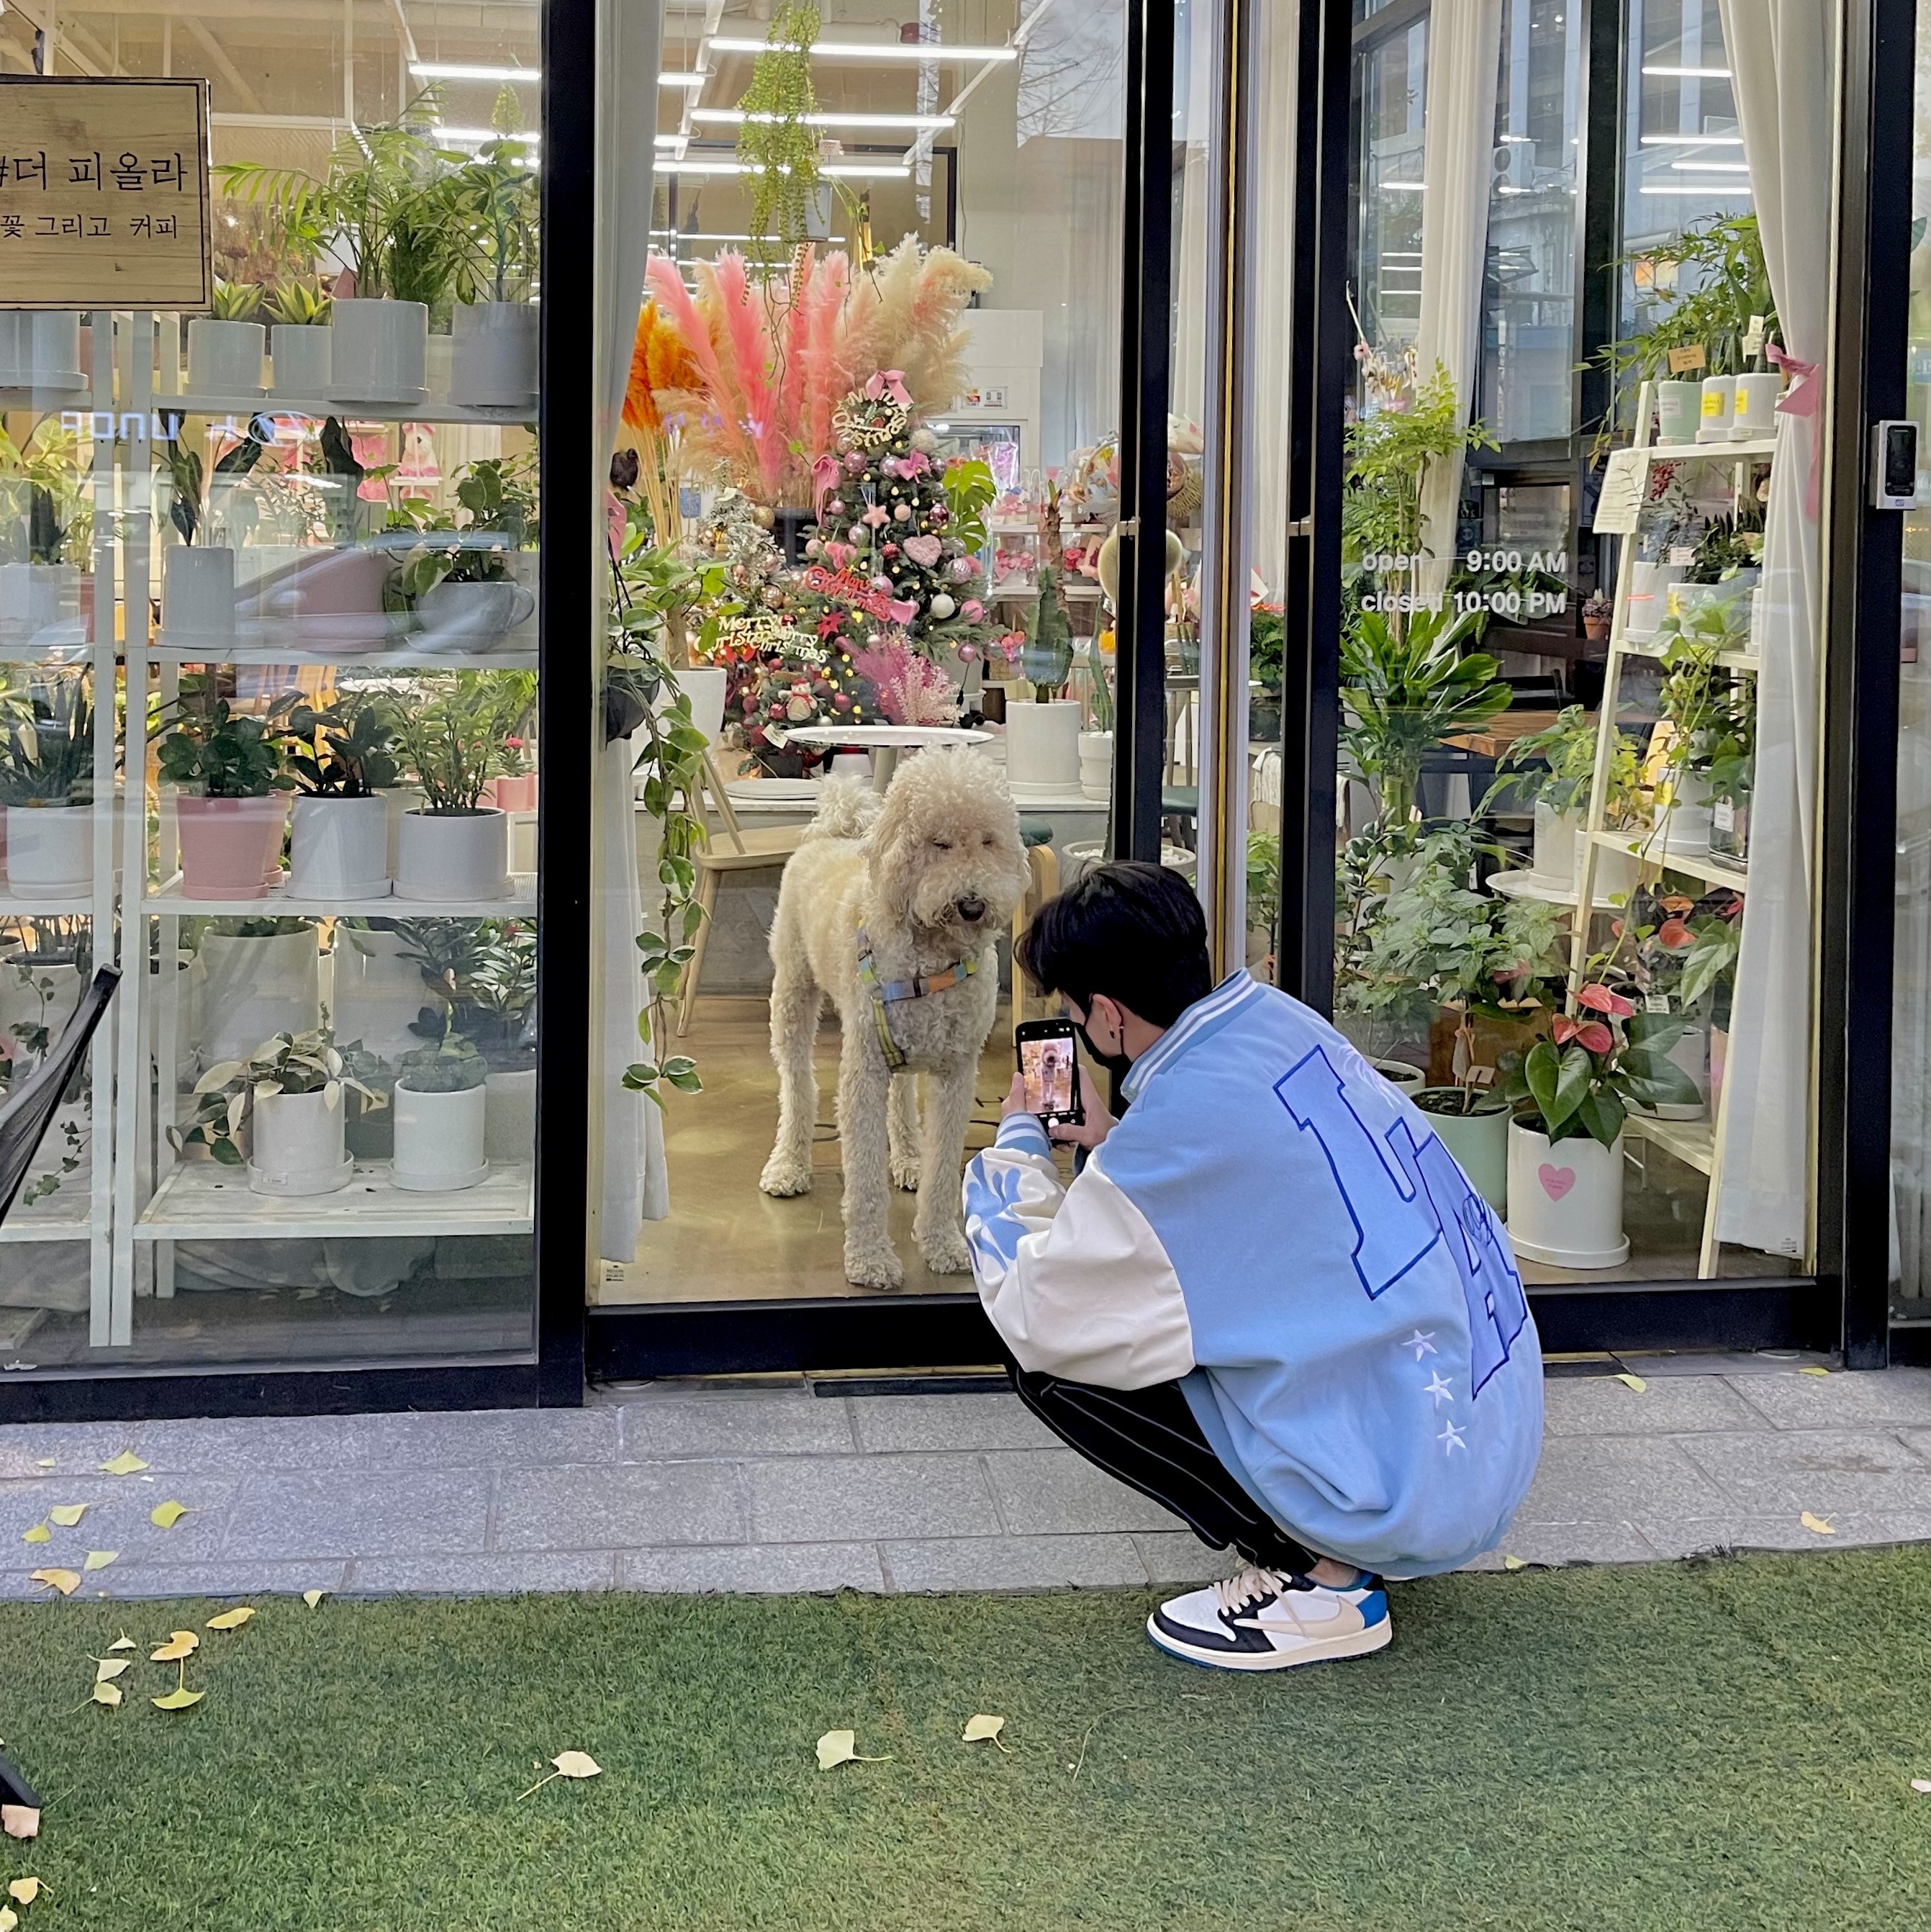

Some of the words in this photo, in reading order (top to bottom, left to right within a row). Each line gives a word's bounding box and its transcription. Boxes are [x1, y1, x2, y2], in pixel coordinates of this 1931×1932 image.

[69, 152, 189, 191] 피올라
[0, 215, 25, 238] 꽃
[35, 214, 112, 239] 그리고
[130, 215, 178, 239] 커피
[1362, 552, 1424, 572] open
[1466, 549, 1521, 573] 9:00
[1527, 551, 1567, 573] AM
[1360, 591, 1443, 613] closed
[1453, 591, 1521, 613] 10:00
[1529, 592, 1567, 614] PM
[718, 614, 778, 633] Merry
